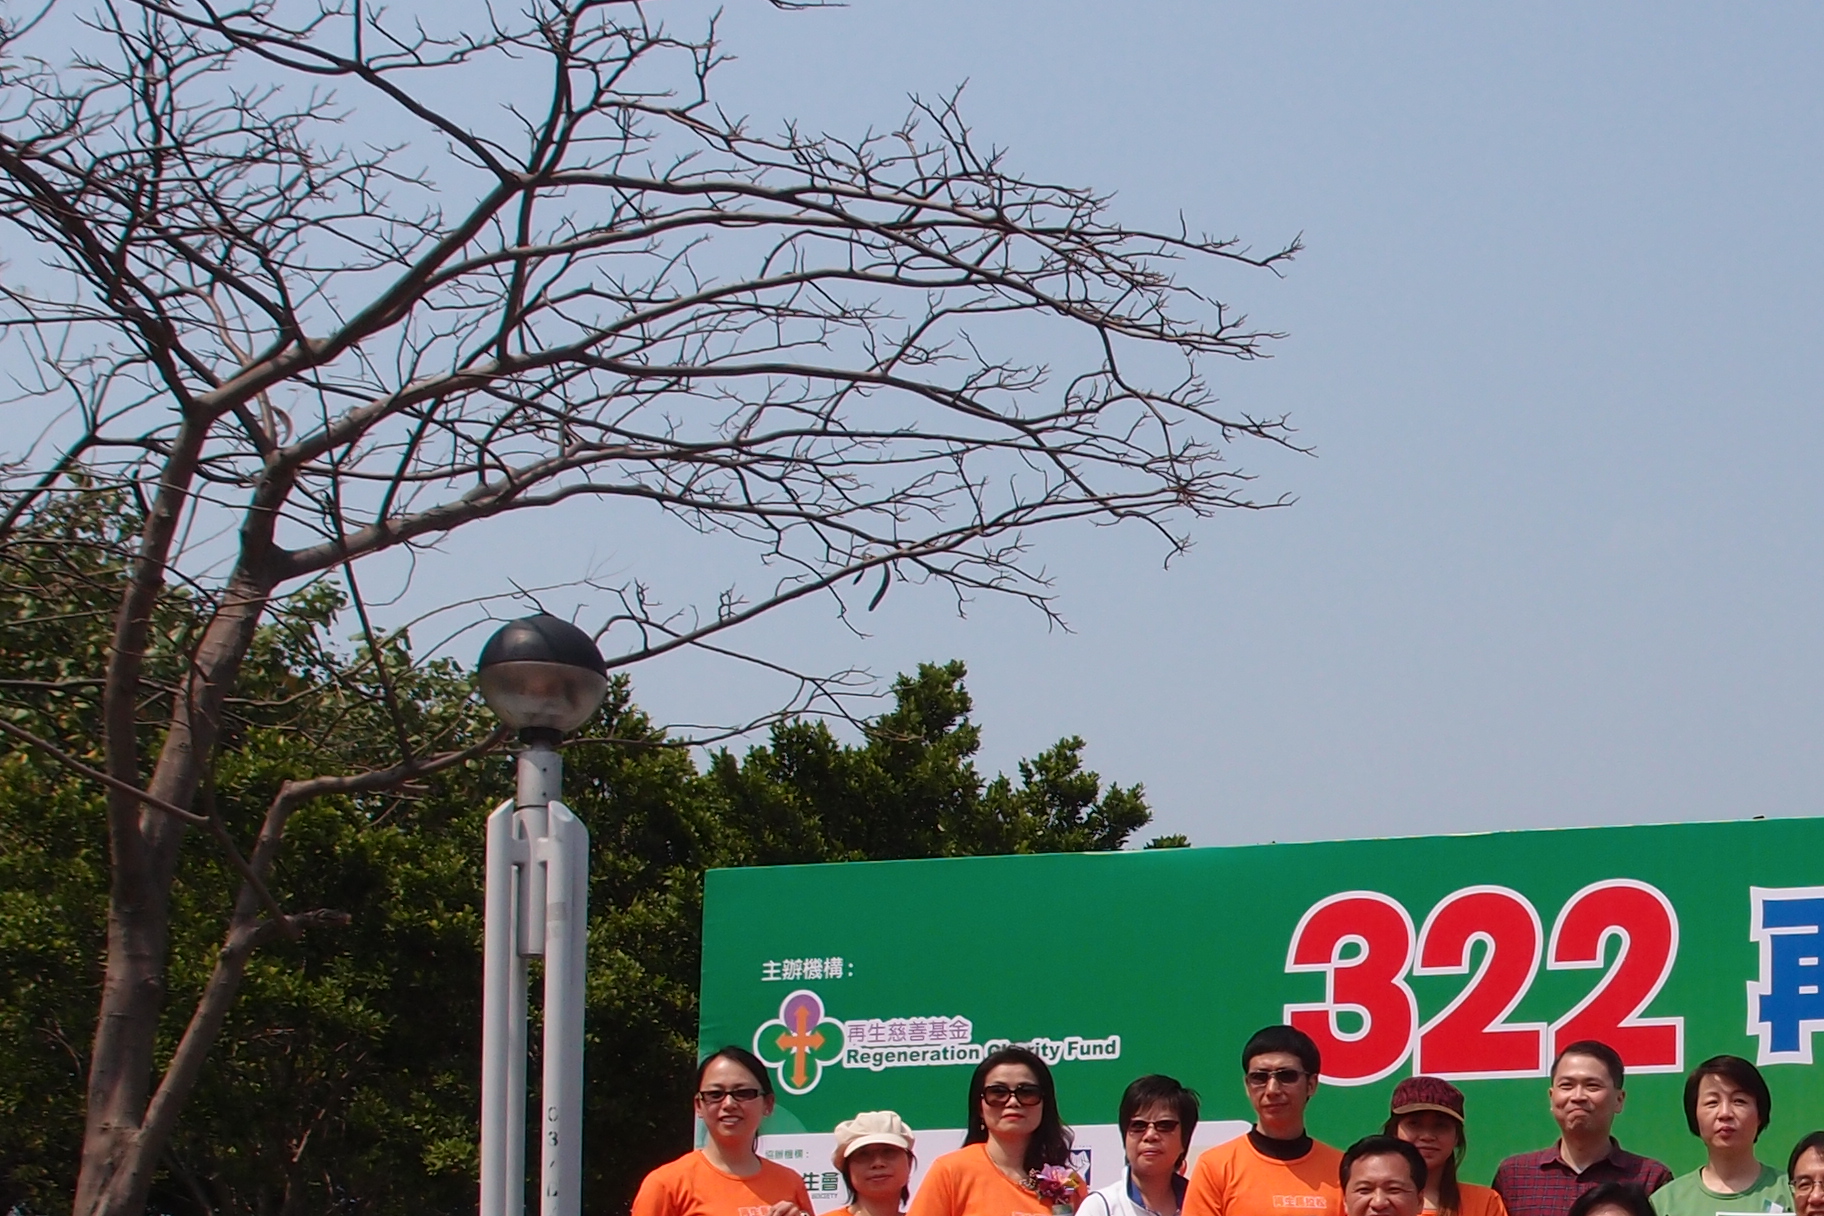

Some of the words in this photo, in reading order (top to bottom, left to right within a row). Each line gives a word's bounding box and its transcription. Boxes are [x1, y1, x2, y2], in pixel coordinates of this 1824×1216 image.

[761, 958, 853, 981] 主辦機構：
[1286, 881, 1682, 1083] 322
[847, 1019, 970, 1043] 再生慈善基金
[847, 1045, 980, 1066] Regeneration
[1068, 1040, 1116, 1056] Fund
